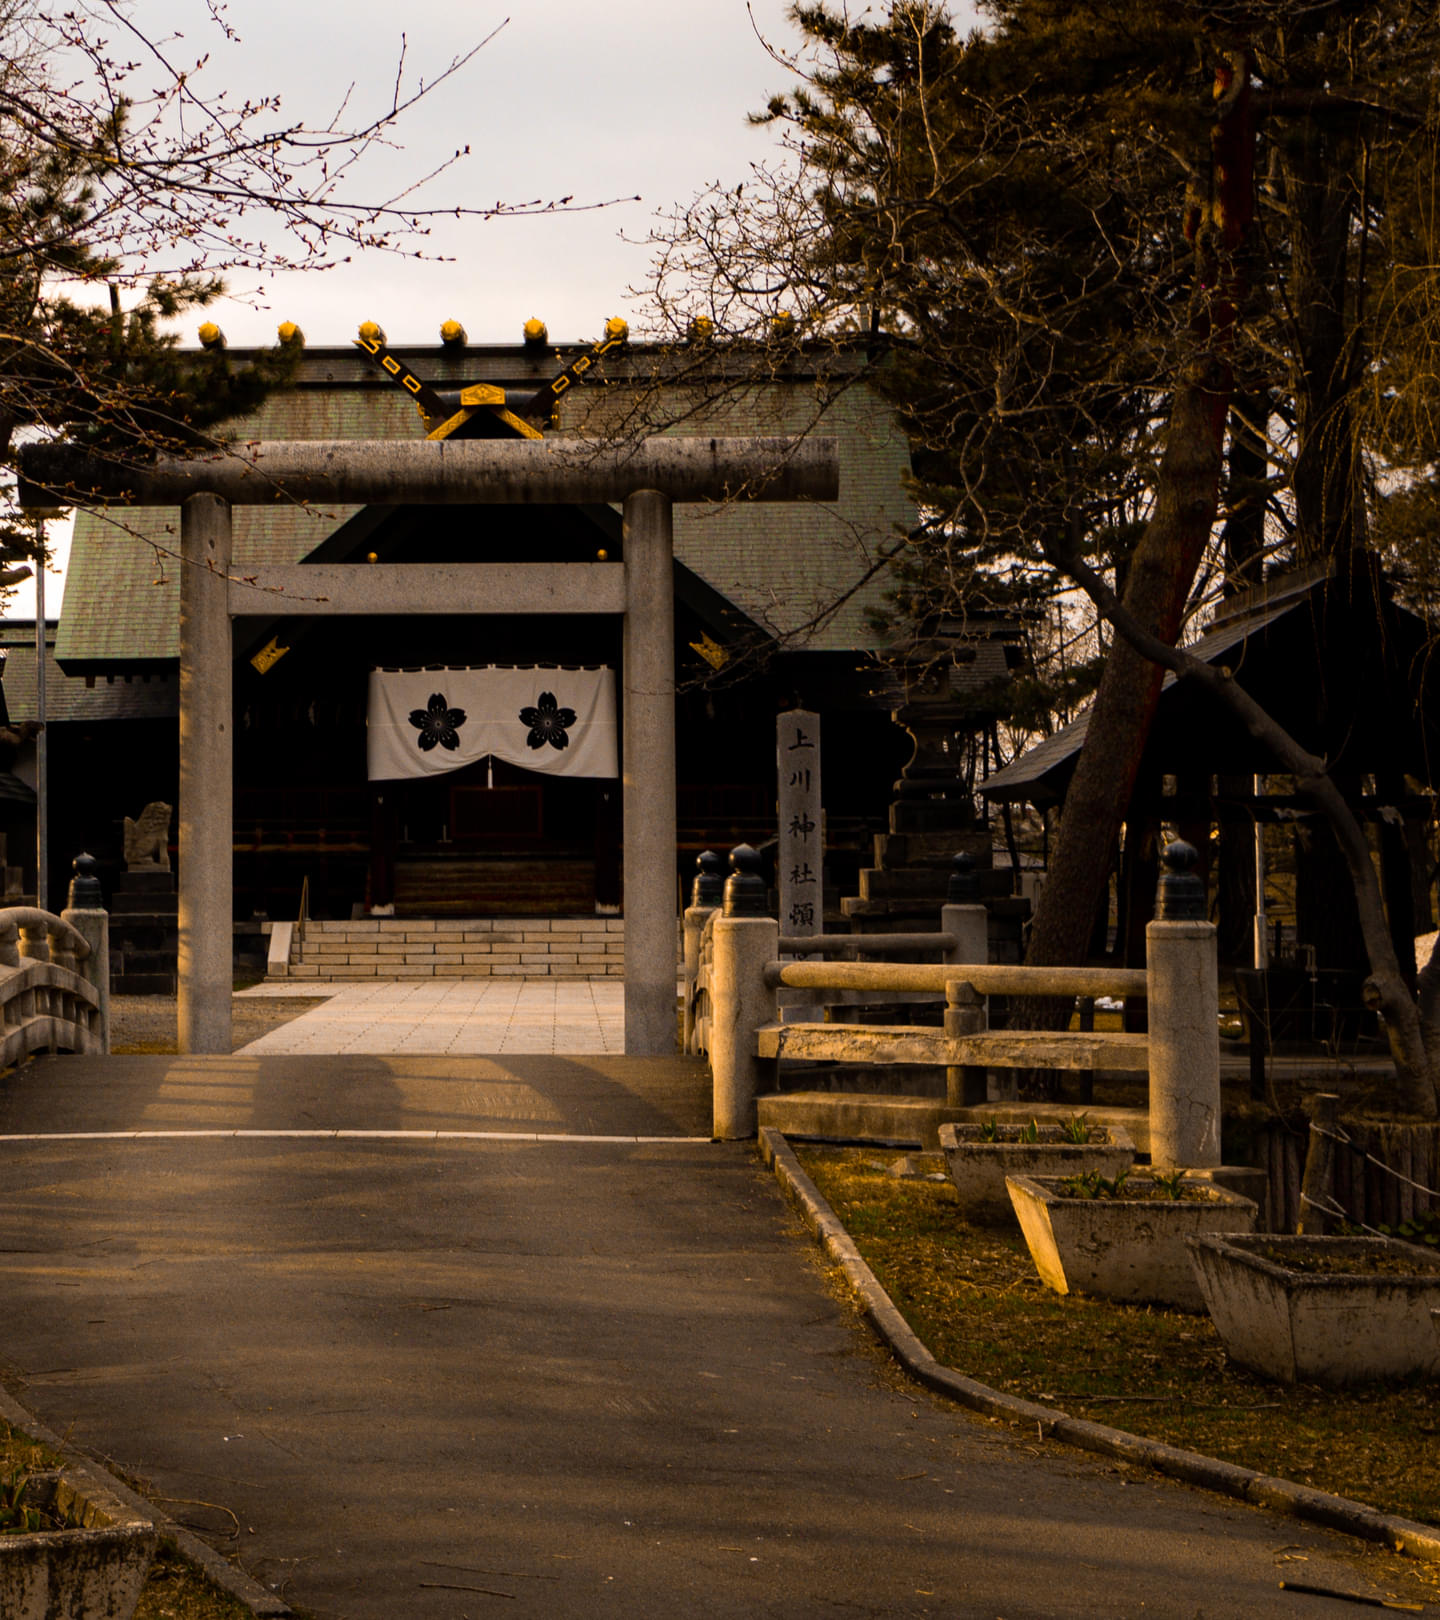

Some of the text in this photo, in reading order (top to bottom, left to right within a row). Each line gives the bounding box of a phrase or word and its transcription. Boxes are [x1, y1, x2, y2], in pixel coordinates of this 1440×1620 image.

[787, 727, 817, 961] 上川神社頓
